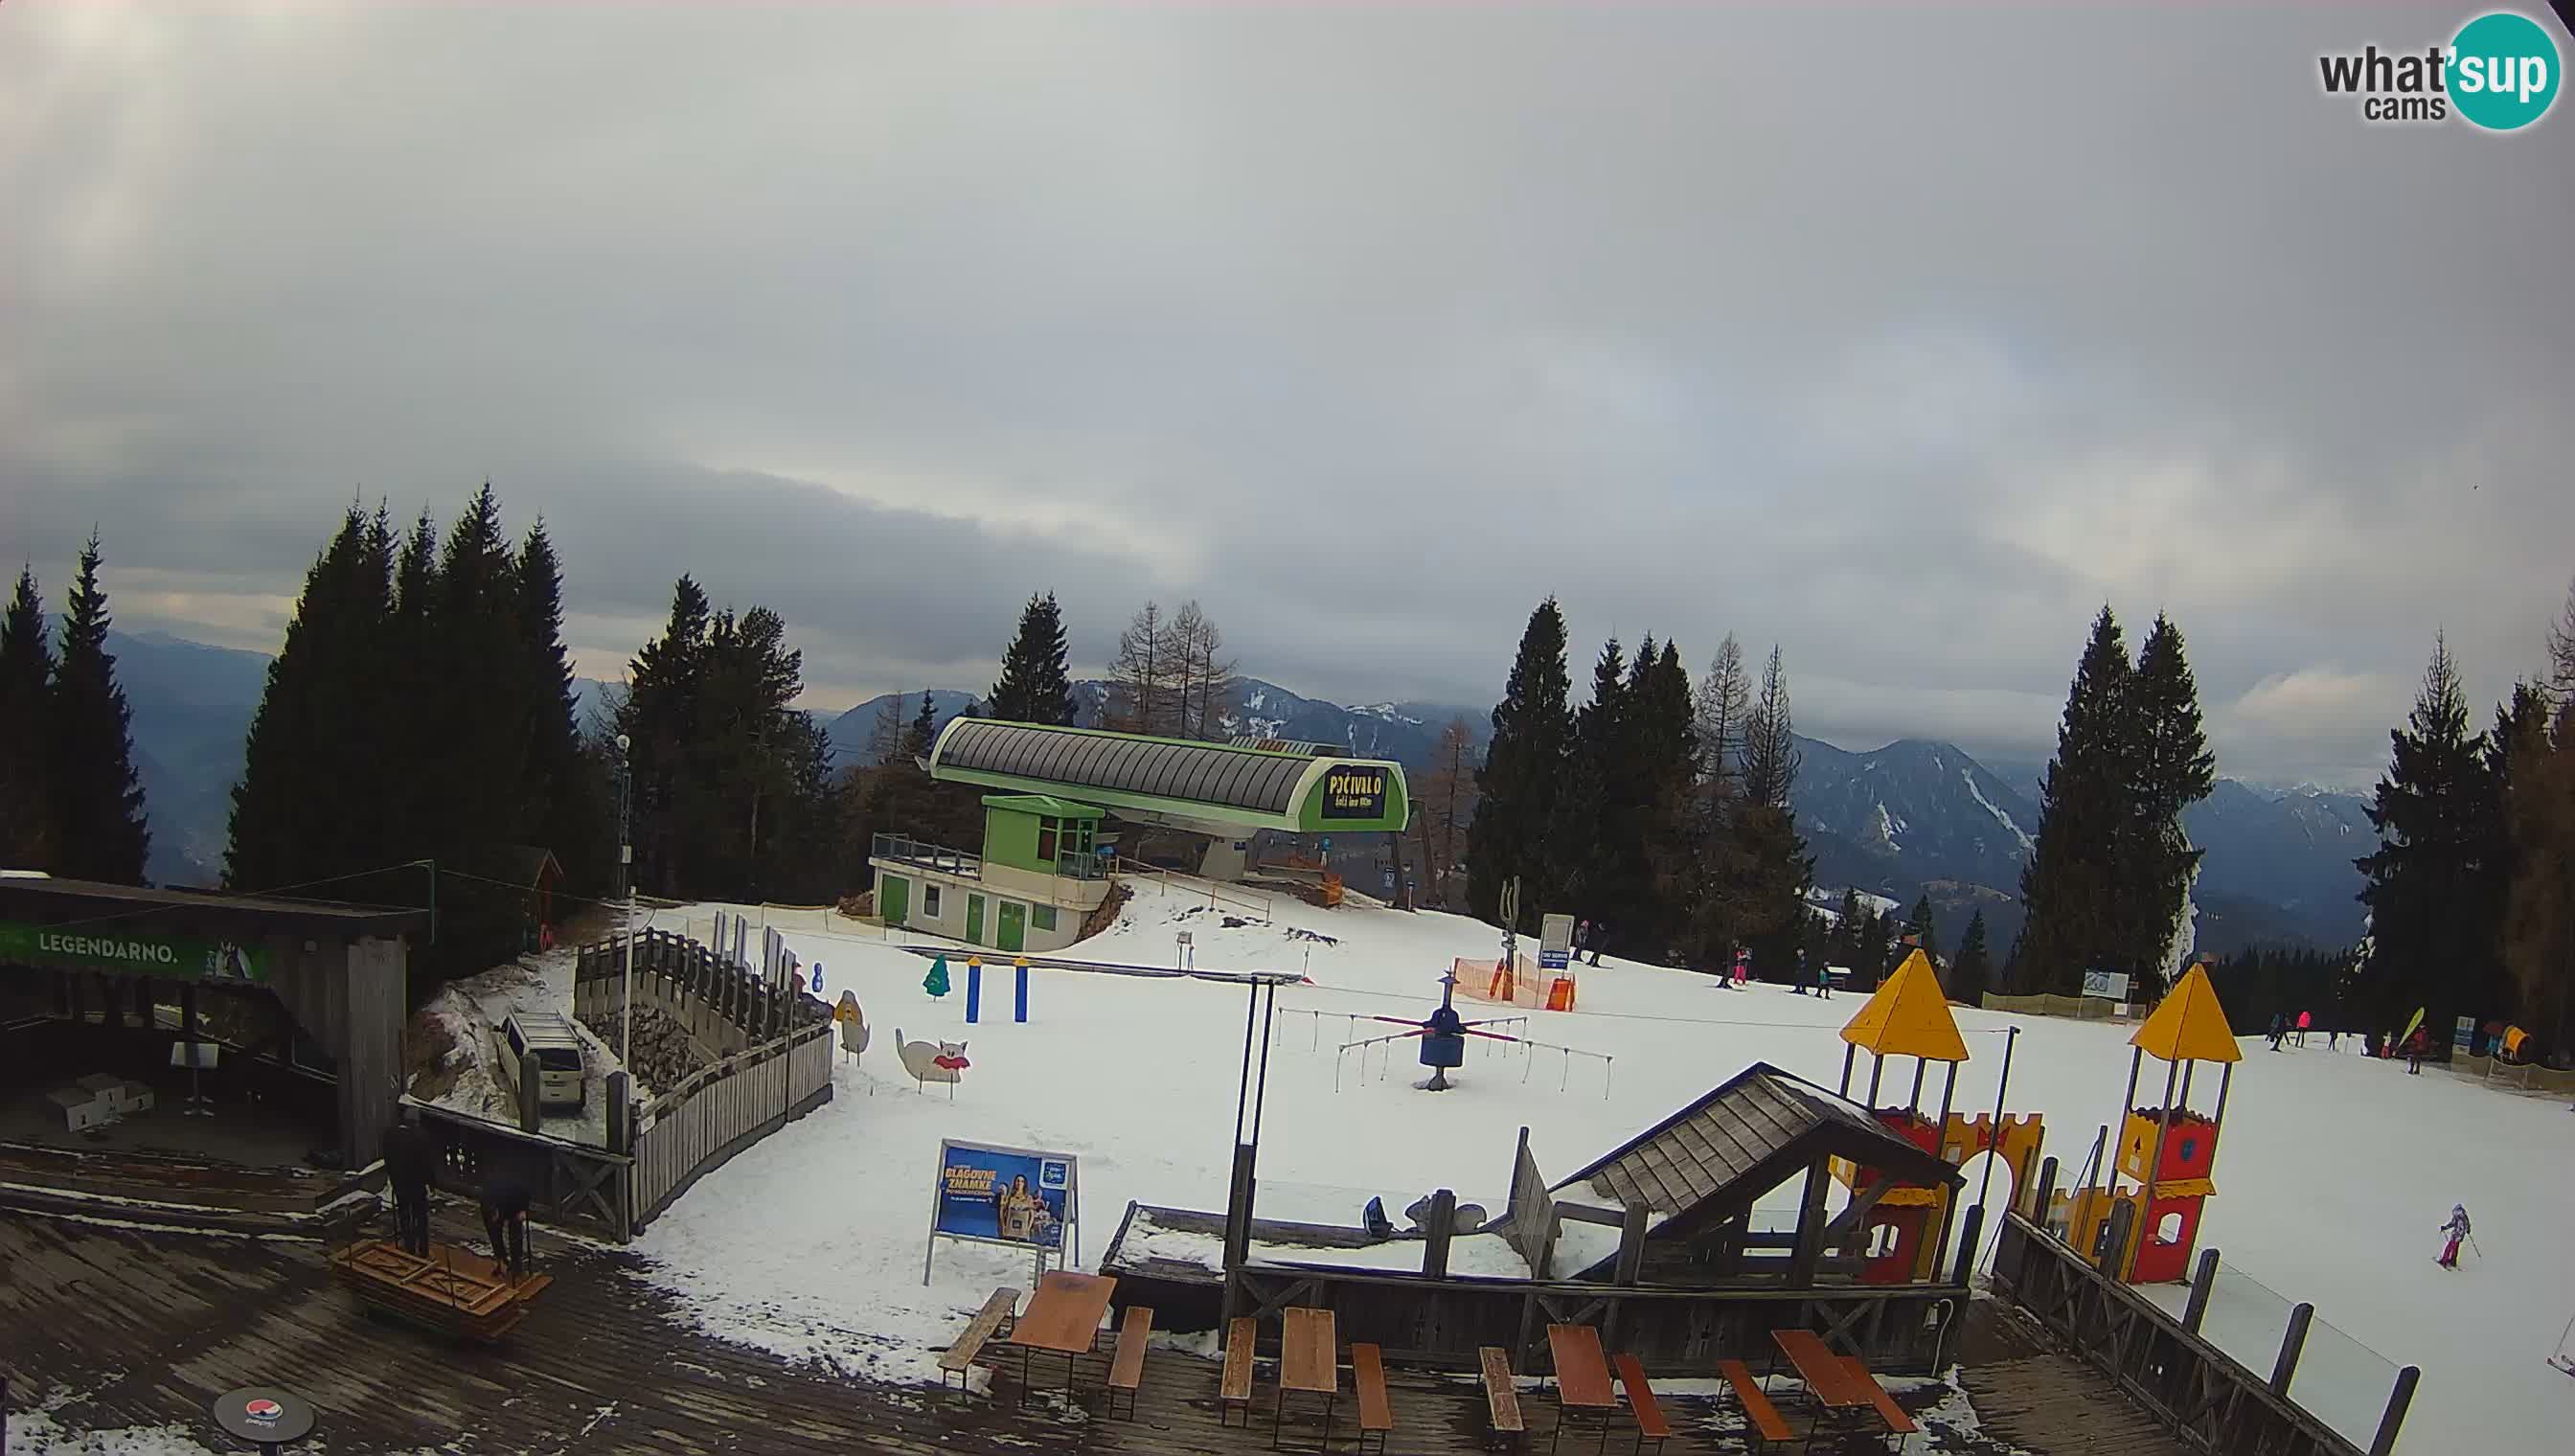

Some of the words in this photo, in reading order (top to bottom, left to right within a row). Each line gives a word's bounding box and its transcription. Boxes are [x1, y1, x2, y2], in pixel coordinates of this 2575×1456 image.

[39, 933, 179, 964] LEGENDARNO.
[946, 1168, 997, 1180] BLAGOVNE
[947, 1178, 992, 1190] ZNAMKE
